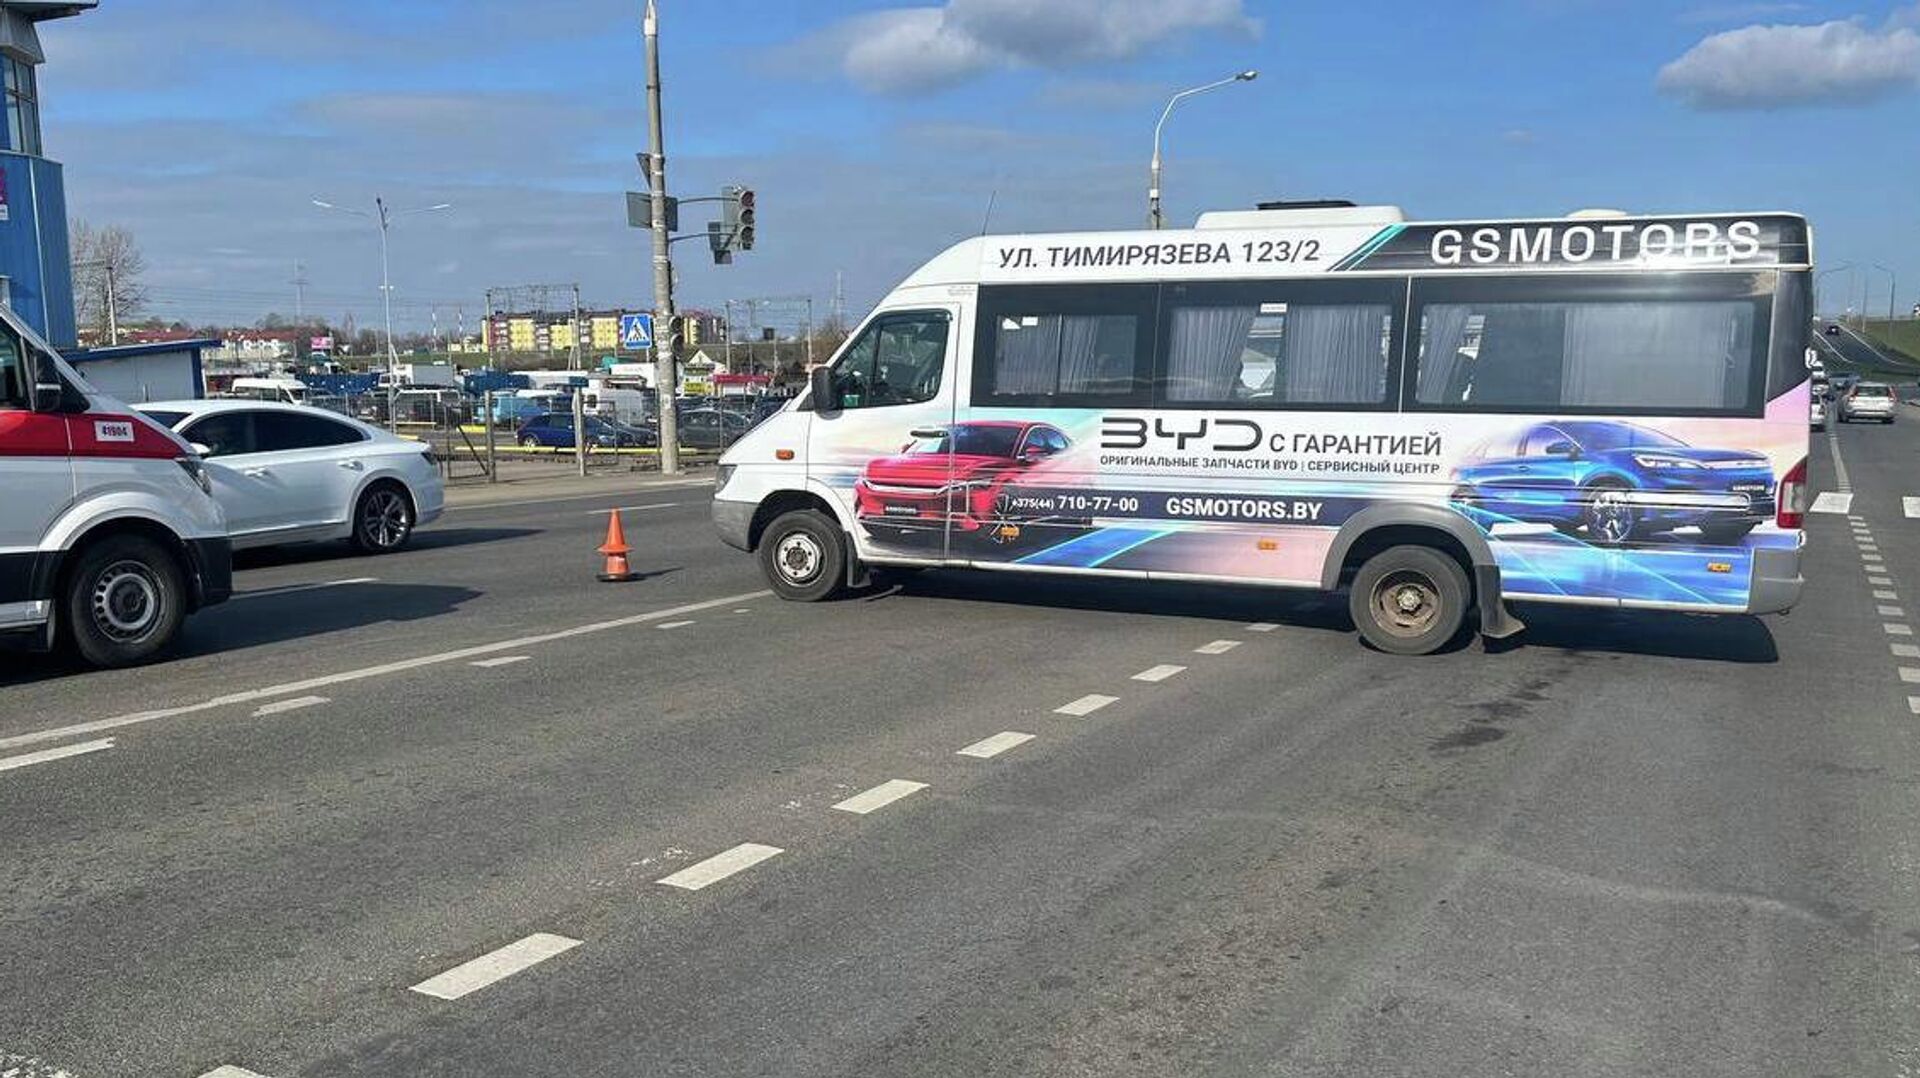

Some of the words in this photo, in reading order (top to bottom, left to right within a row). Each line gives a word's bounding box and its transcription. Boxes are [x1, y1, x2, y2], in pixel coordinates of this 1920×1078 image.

[999, 248, 1038, 268] УЛ.
[1047, 243, 1231, 267] ТИМИРЯЗЕВА
[1242, 240, 1321, 262] 123/2
[1430, 220, 1762, 265] GSMOTORS
[1100, 417, 1263, 451] BYD
[1269, 433, 1285, 453] С
[1293, 431, 1442, 456] ГАРАНТИЕЙ
[1100, 455, 1199, 468] ОРИГИНАЛЬНЫЕ
[1202, 457, 1270, 470] ЗАПЧАСТИ
[1273, 459, 1298, 470] BYD
[1307, 460, 1391, 473] СЕРВИСНЫЙ
[1393, 463, 1440, 475] ЦЕНТР
[1011, 498, 1054, 510] +375(44)
[1057, 495, 1139, 511] 710-77-00
[1165, 497, 1323, 520] GSMOTORS.BY
